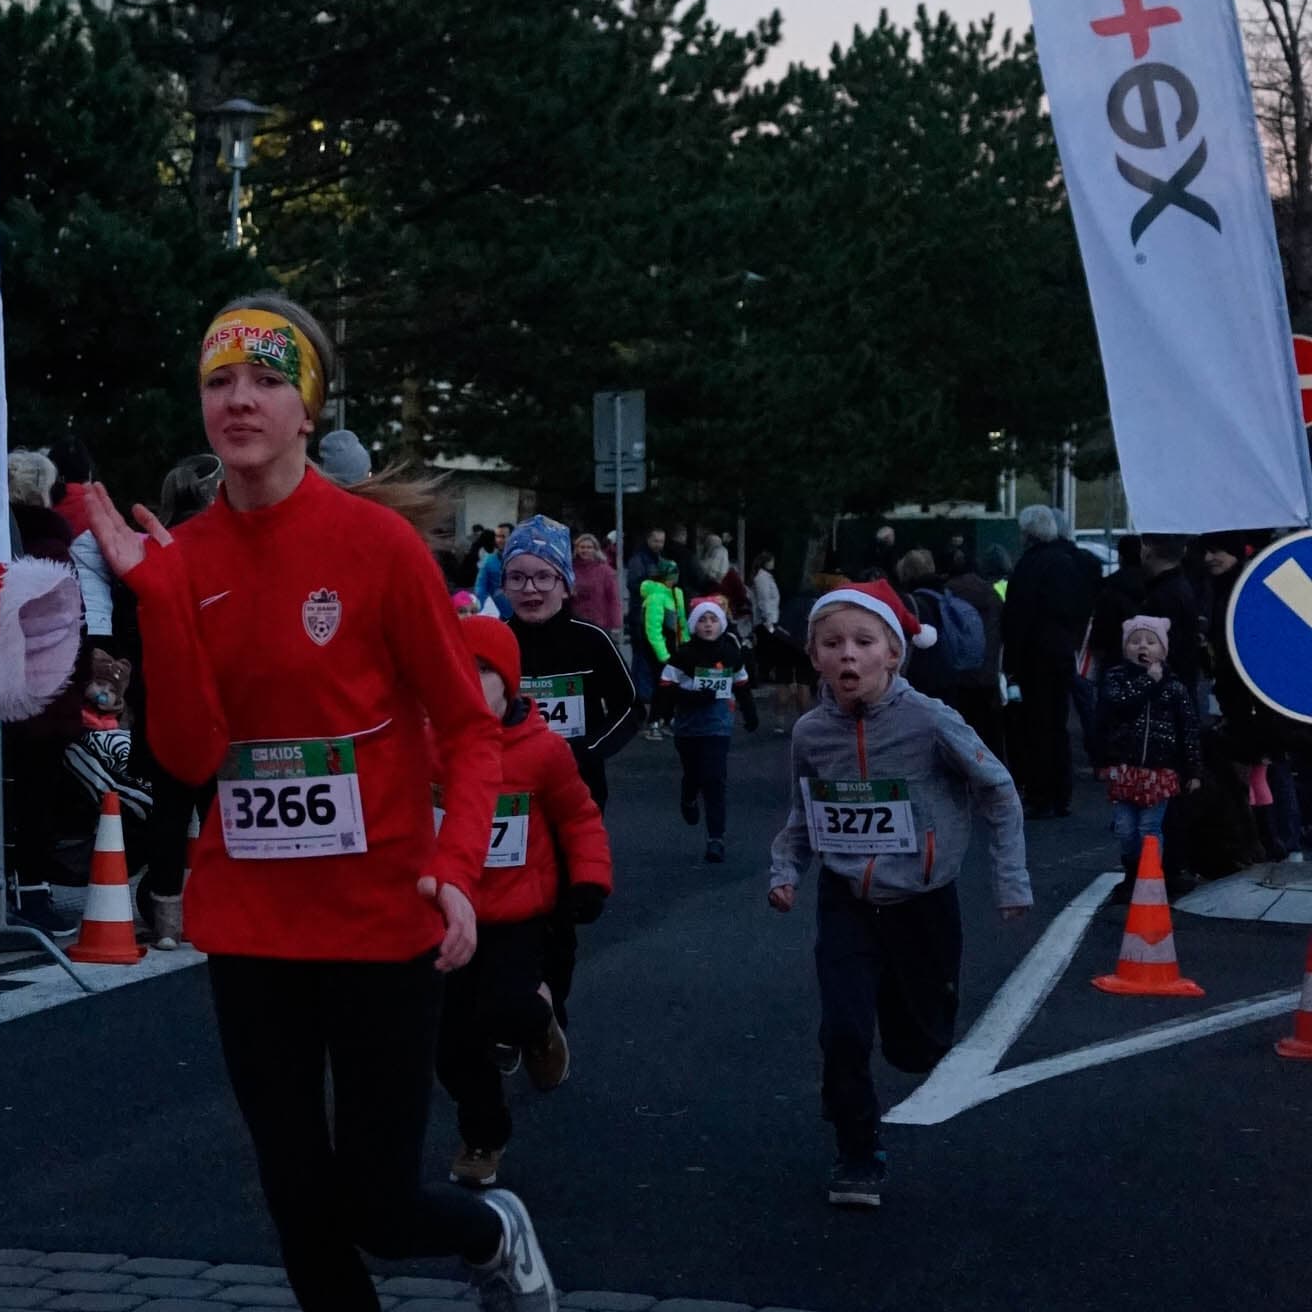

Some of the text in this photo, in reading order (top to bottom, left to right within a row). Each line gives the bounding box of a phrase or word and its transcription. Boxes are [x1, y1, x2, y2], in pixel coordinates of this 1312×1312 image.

[204, 326, 287, 351] RISTMAS
[244, 338, 285, 359] RUN
[699, 679, 728, 691] 3248
[537, 701, 568, 724] 64
[268, 746, 304, 761] KIDS
[232, 784, 337, 829] 3266
[824, 806, 895, 834] 3272
